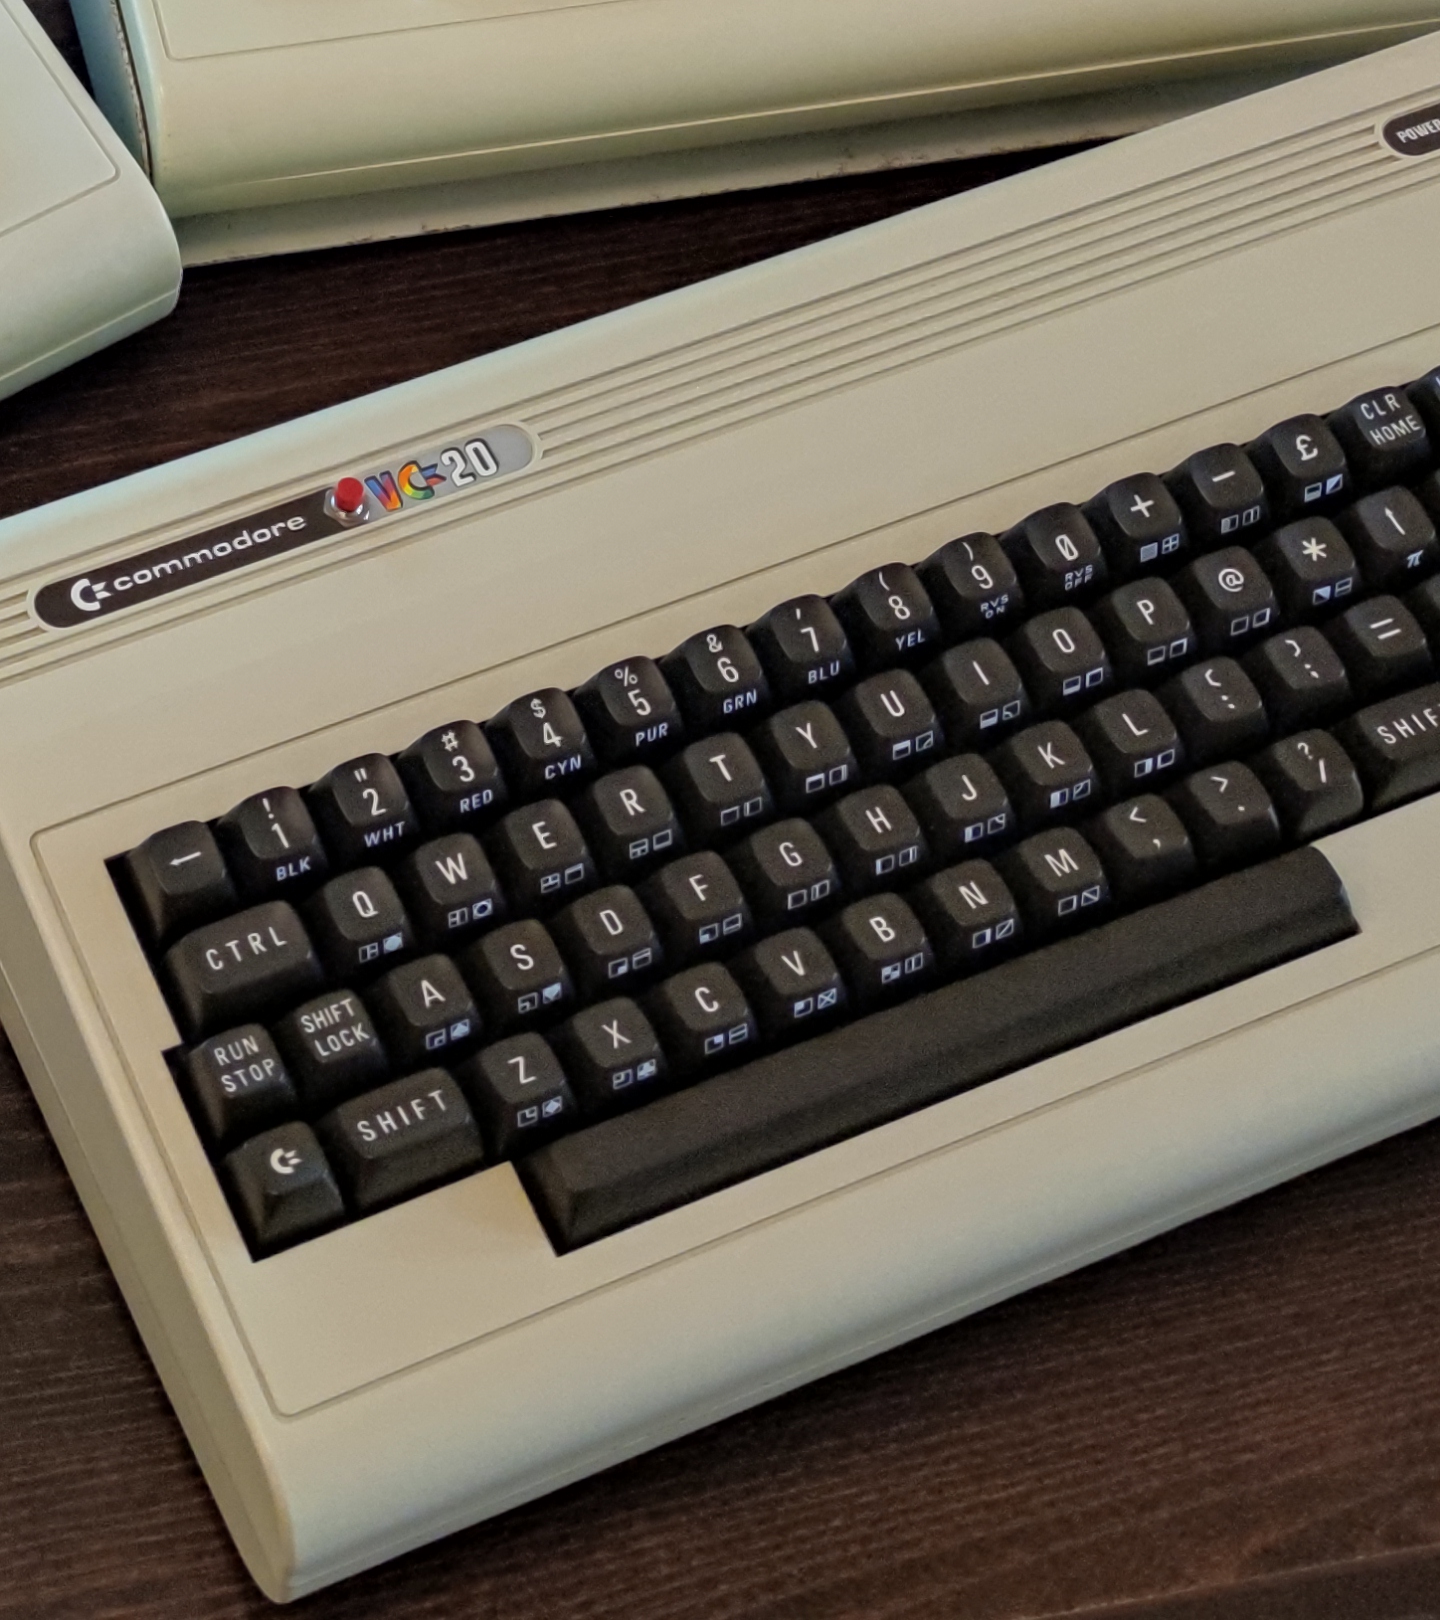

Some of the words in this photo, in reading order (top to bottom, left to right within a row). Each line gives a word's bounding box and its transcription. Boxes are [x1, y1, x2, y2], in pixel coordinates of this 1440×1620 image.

[1359, 393, 1401, 421] CLR
[1370, 415, 1422, 447] HOME
[113, 513, 307, 592] commodore
[895, 628, 925, 651] YEL
[806, 659, 842, 685] BLU
[721, 689, 760, 714] GRN
[632, 722, 671, 746] PUR
[795, 723, 822, 750] Y
[542, 755, 584, 780] CYN
[708, 755, 733, 781] T
[456, 788, 495, 815] RED
[620, 789, 647, 816] R
[361, 822, 408, 850] WHT
[531, 822, 558, 850] E
[273, 855, 312, 884] BLK
[435, 855, 471, 884] W
[350, 890, 380, 920] Q
[205, 925, 288, 974] CTRL
[300, 999, 357, 1034] SHIFT
[213, 1034, 261, 1068] RUN
[314, 1023, 372, 1058] LOCK
[220, 1058, 277, 1093] STOP
[355, 1091, 449, 1143] SHIFT
